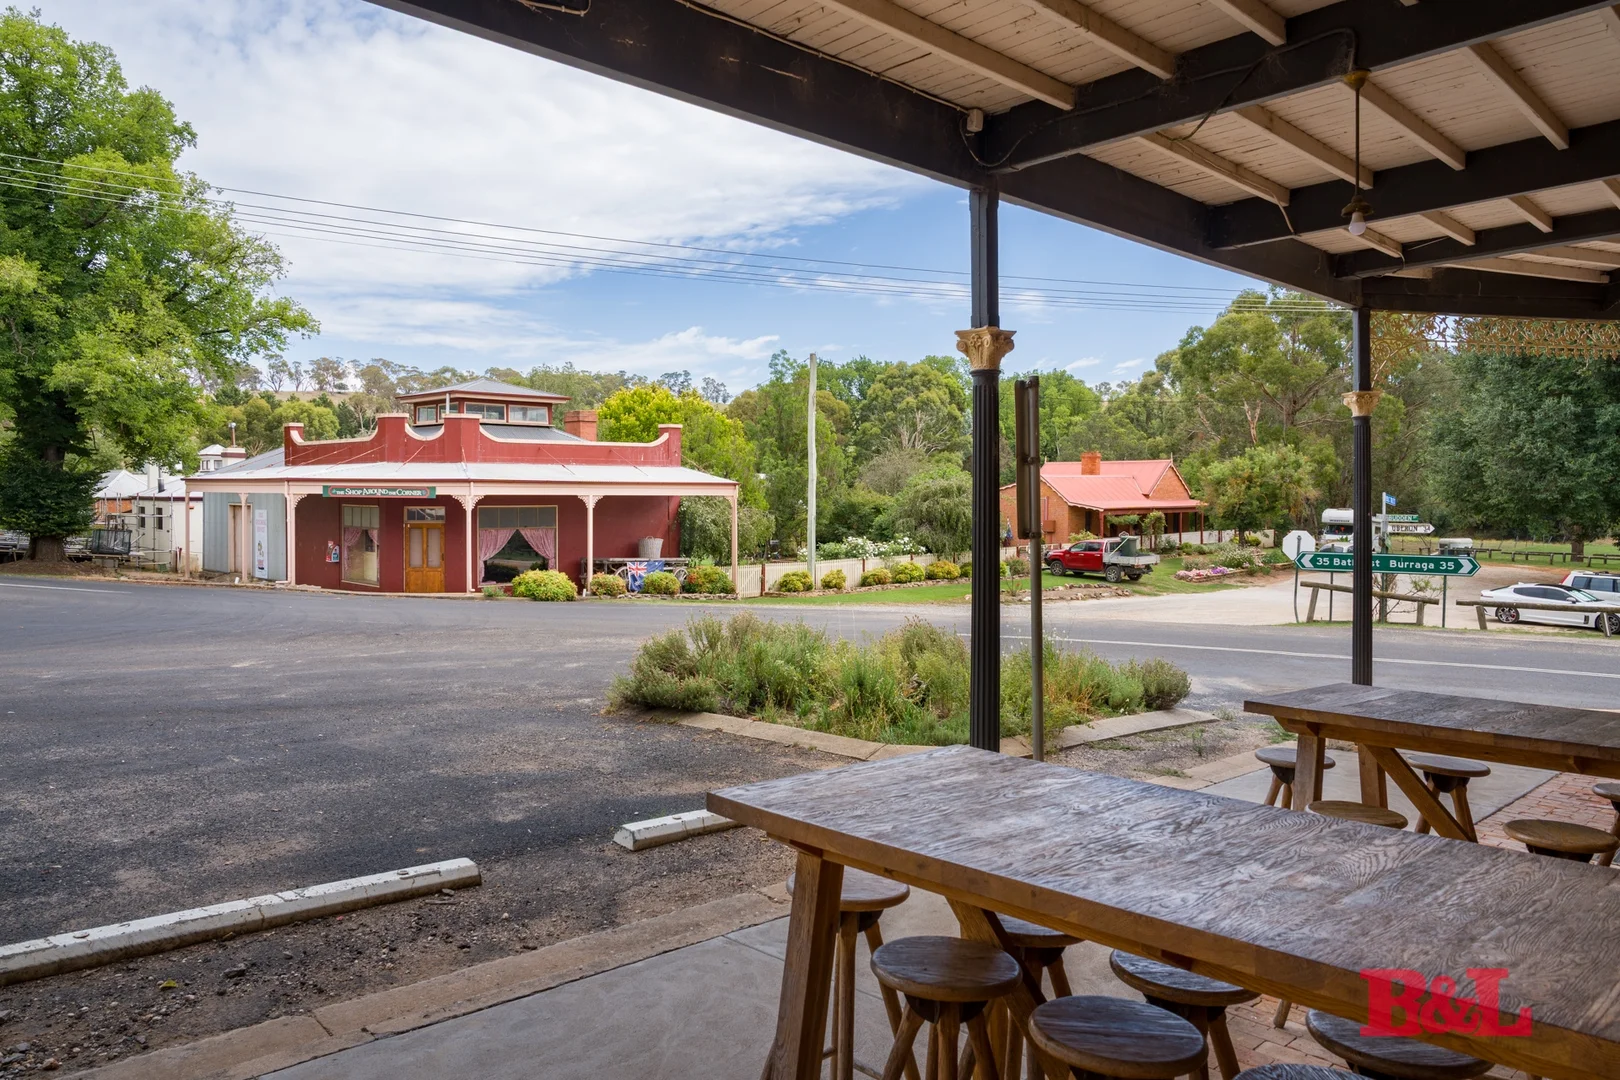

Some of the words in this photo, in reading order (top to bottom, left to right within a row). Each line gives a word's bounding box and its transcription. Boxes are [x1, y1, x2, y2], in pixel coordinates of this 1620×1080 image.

[363, 488, 388, 496] AROUND
[1316, 558, 1330, 566] 35
[1333, 558, 1380, 567] Batst
[1389, 559, 1434, 571] Burraga
[1439, 562, 1455, 570] 35
